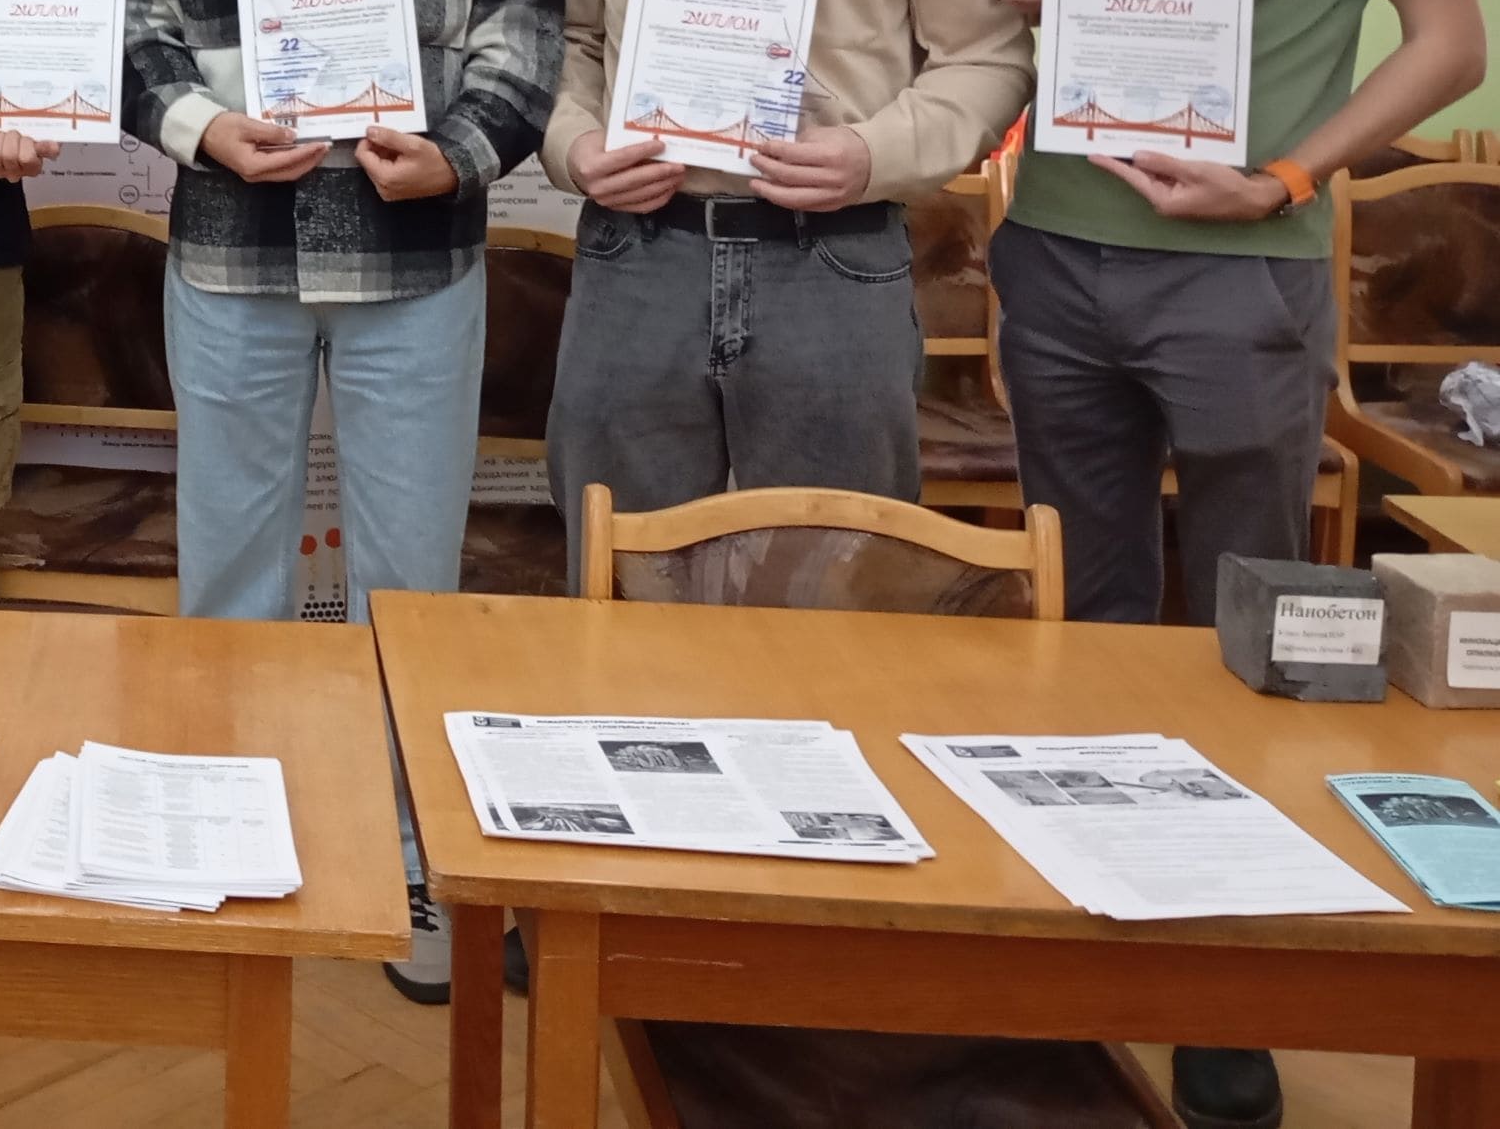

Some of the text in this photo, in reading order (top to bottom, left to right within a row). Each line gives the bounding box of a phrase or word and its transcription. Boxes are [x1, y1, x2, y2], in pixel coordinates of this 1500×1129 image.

[280, 37, 300, 51] 22
[783, 69, 805, 86] 22
[1280, 602, 1377, 621] Нанобетон
